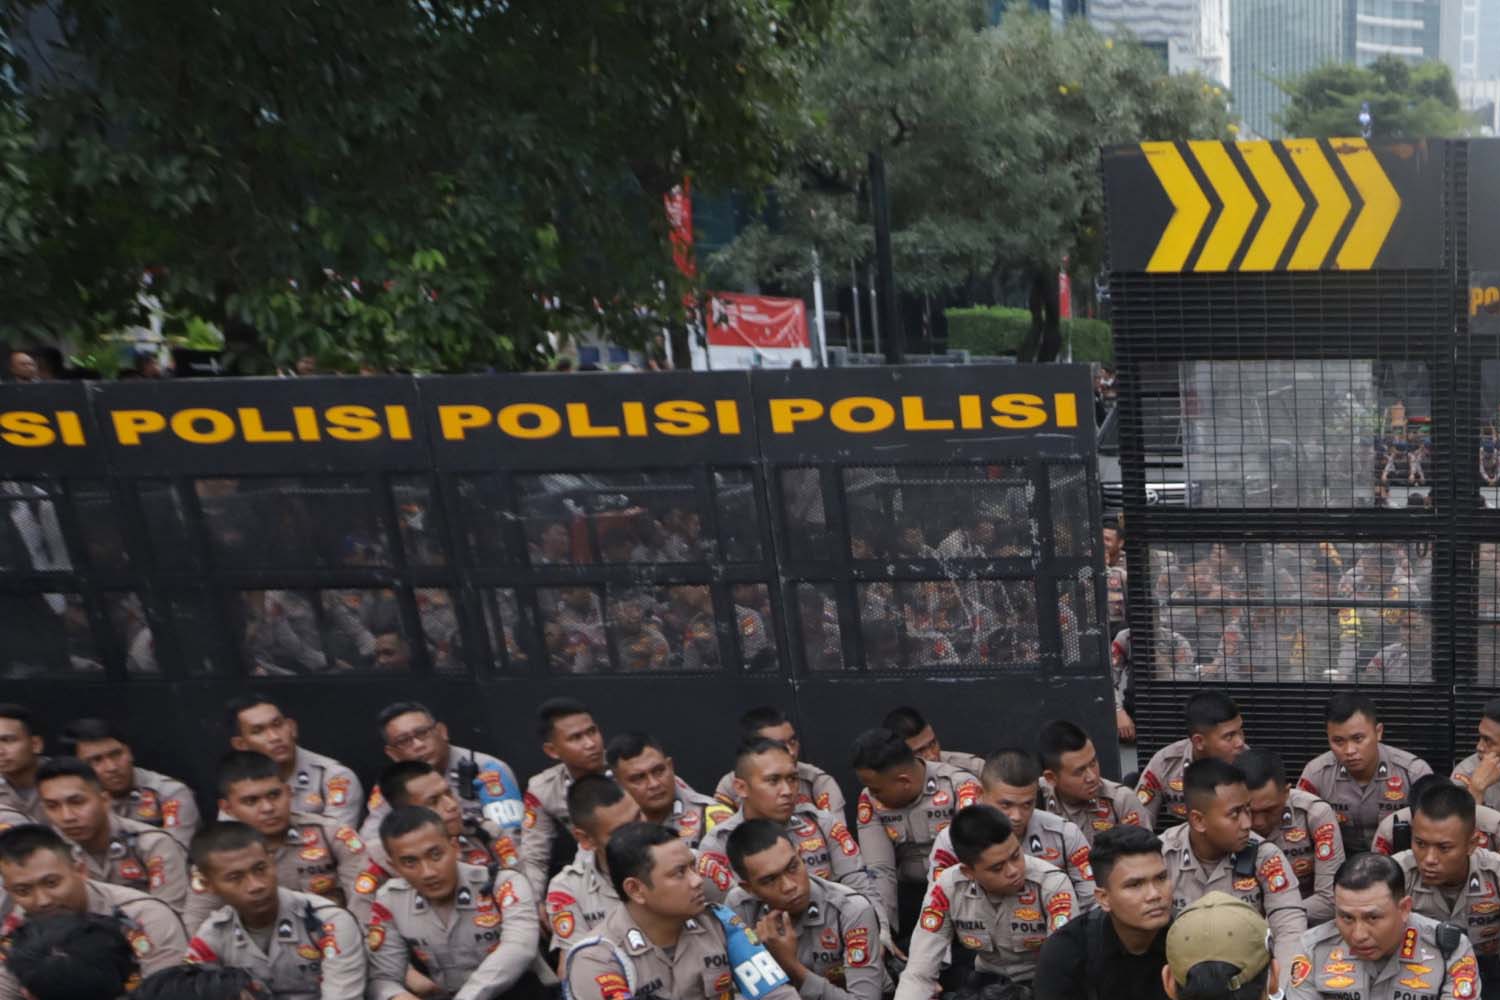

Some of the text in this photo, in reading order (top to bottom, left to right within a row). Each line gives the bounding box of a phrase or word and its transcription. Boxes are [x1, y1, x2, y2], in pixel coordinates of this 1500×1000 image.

[110, 405, 413, 446] POLISI
[438, 400, 742, 440] POLISI
[768, 392, 1078, 434] POLISI
